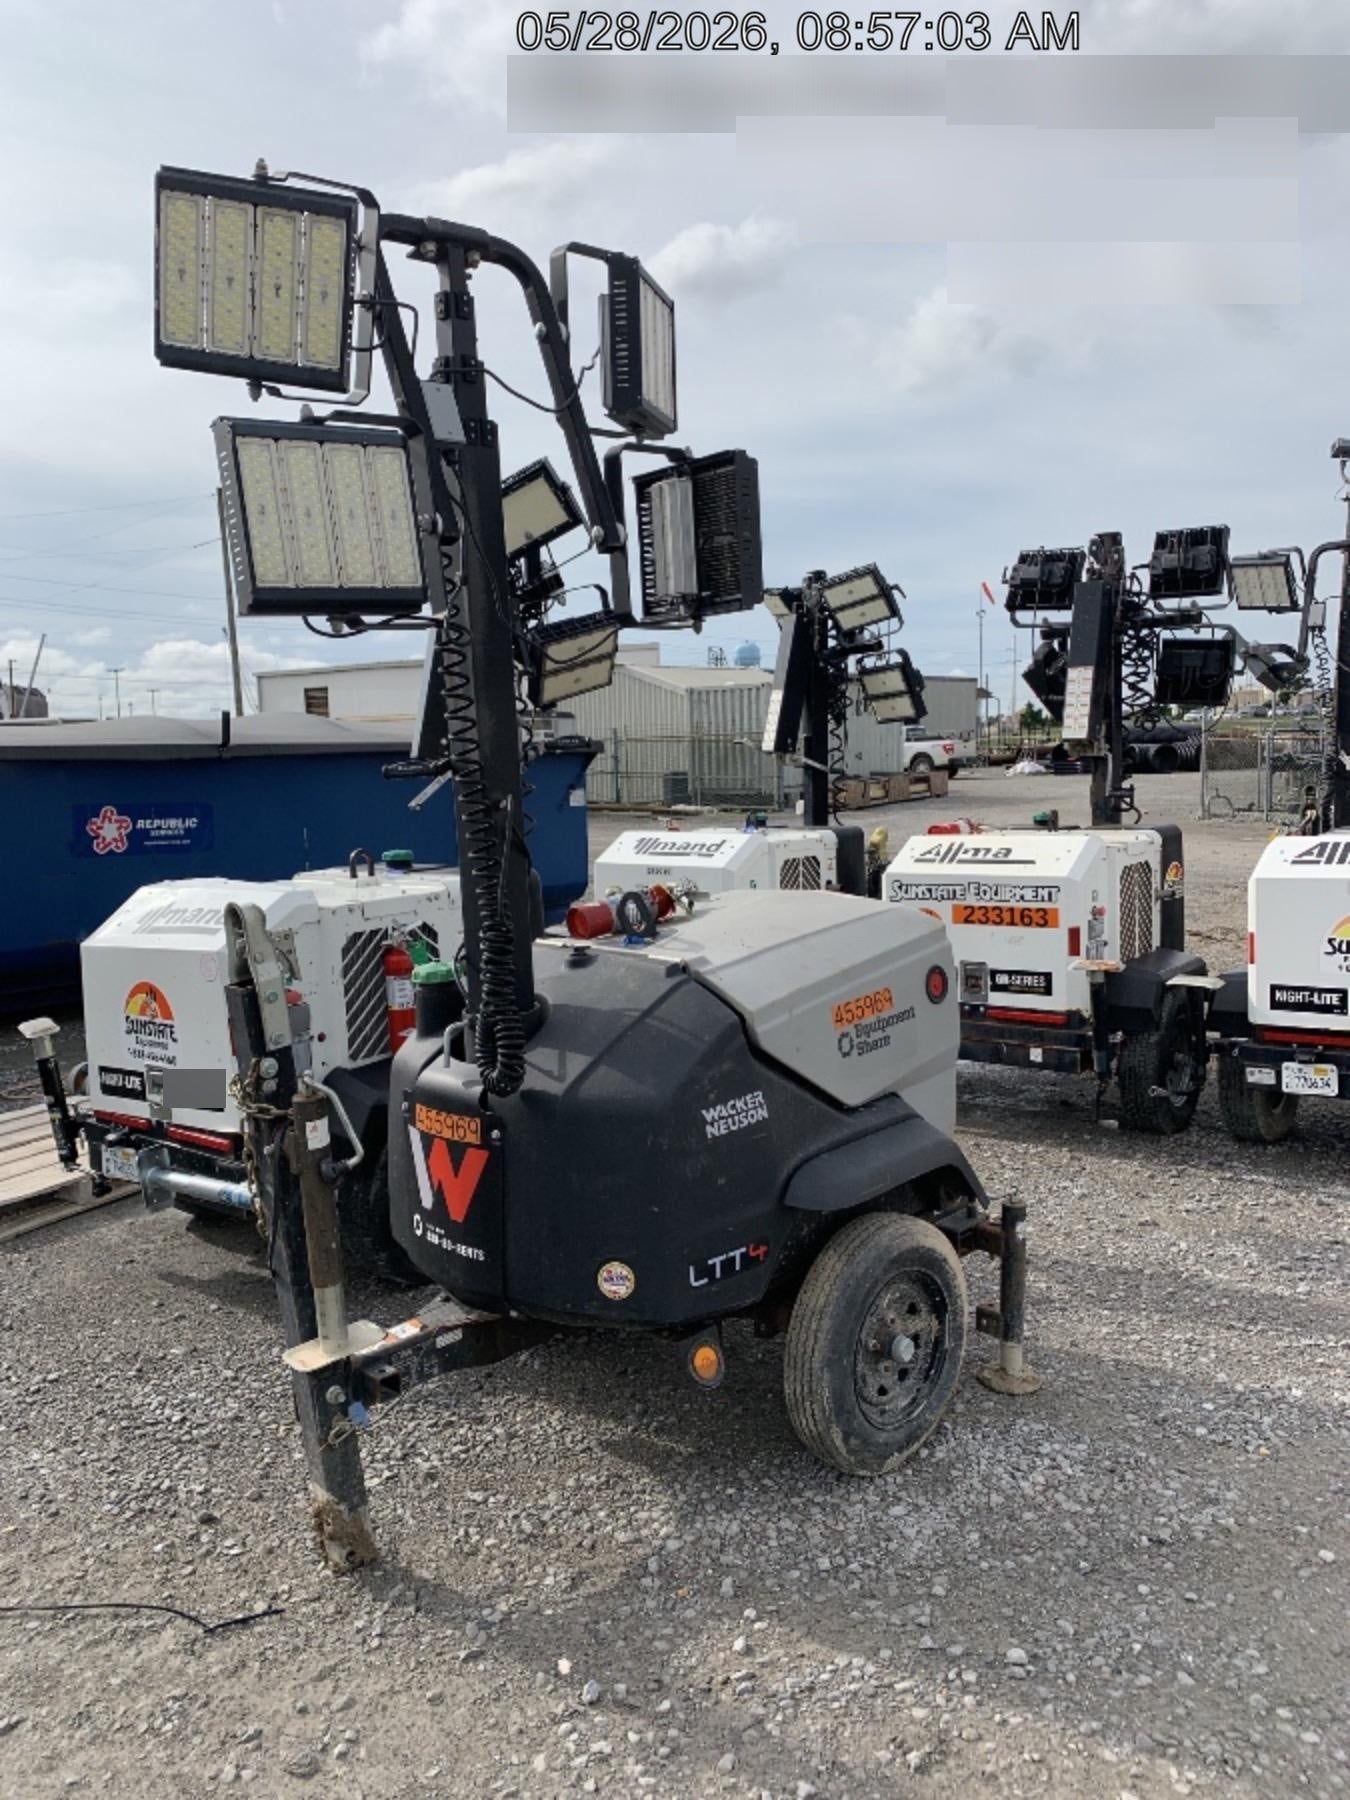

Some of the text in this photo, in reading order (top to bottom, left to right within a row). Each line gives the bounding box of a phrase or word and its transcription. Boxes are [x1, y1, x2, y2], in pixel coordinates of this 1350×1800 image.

[136, 817, 199, 829] REPUBLIC
[890, 879, 1061, 904] SUNSTATE EQUIPMENT
[962, 905, 1050, 928] 233163
[834, 987, 893, 1025] 455969
[1275, 988, 1343, 1006] NIGHT-LITE
[125, 1015, 179, 1043] SUNSTATE
[854, 1005, 916, 1039] Equipment
[856, 1034, 891, 1057] Share
[701, 1090, 765, 1123] WACKER
[705, 1103, 769, 1139] NEUSON
[416, 1104, 479, 1143] 455969
[688, 1243, 768, 1288] LTT4
